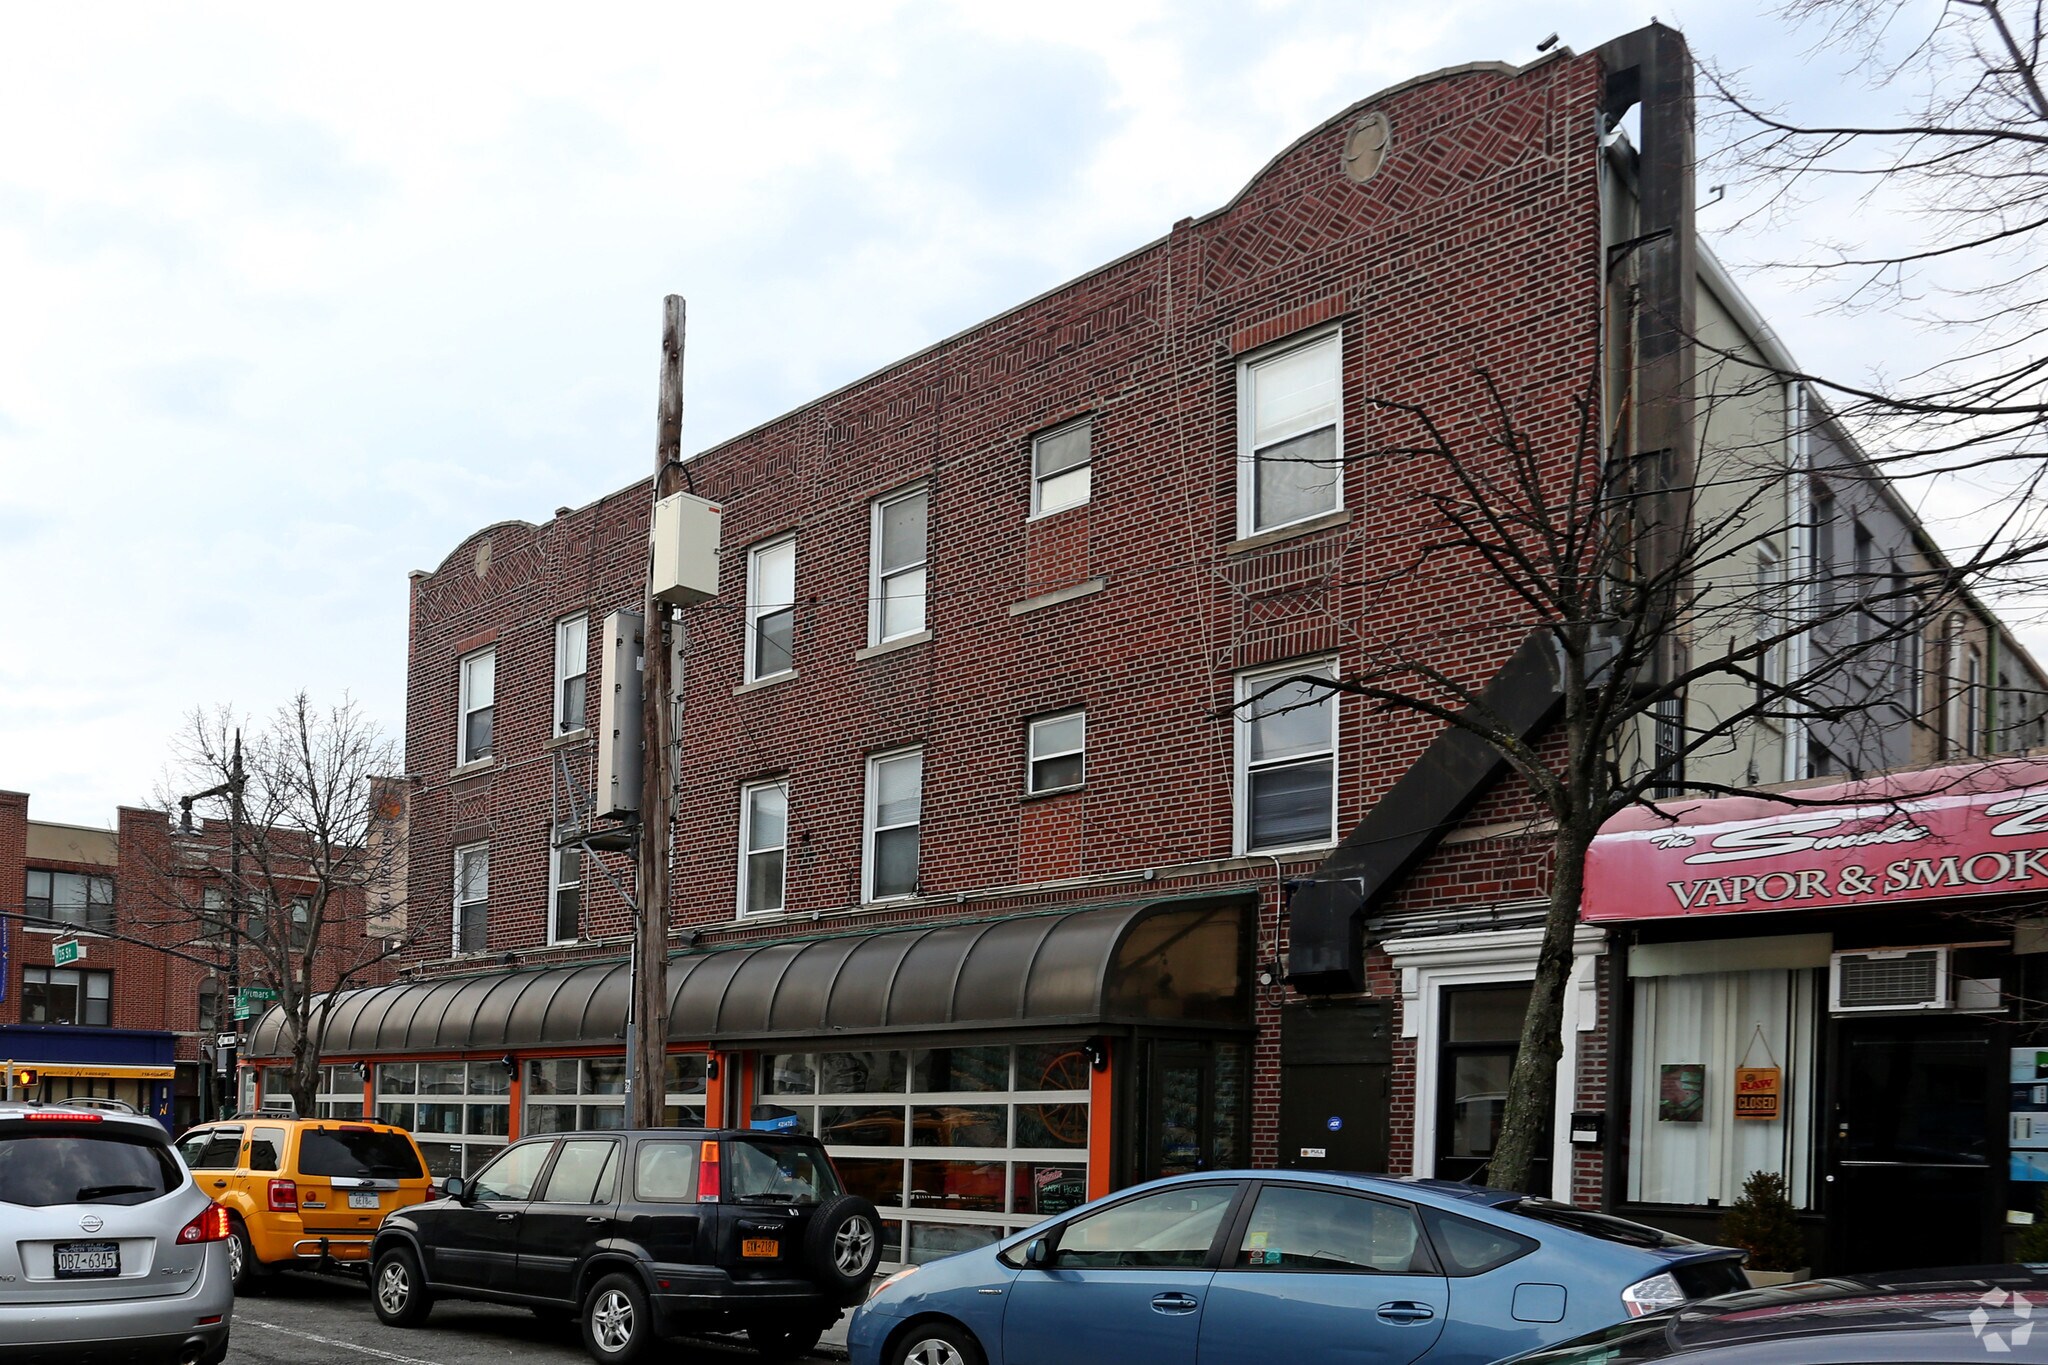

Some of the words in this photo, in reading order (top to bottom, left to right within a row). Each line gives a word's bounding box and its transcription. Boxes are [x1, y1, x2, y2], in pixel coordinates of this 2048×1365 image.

[1650, 833, 1696, 851] The
[1683, 817, 1930, 865] Smoke
[1668, 868, 1832, 910] VAPOR
[1837, 865, 1877, 896] &
[1740, 1078, 1774, 1091] RAW
[1738, 1096, 1775, 1109] CLOSED
[60, 1253, 81, 1270] DBZ
[88, 1252, 114, 1269] 6345
